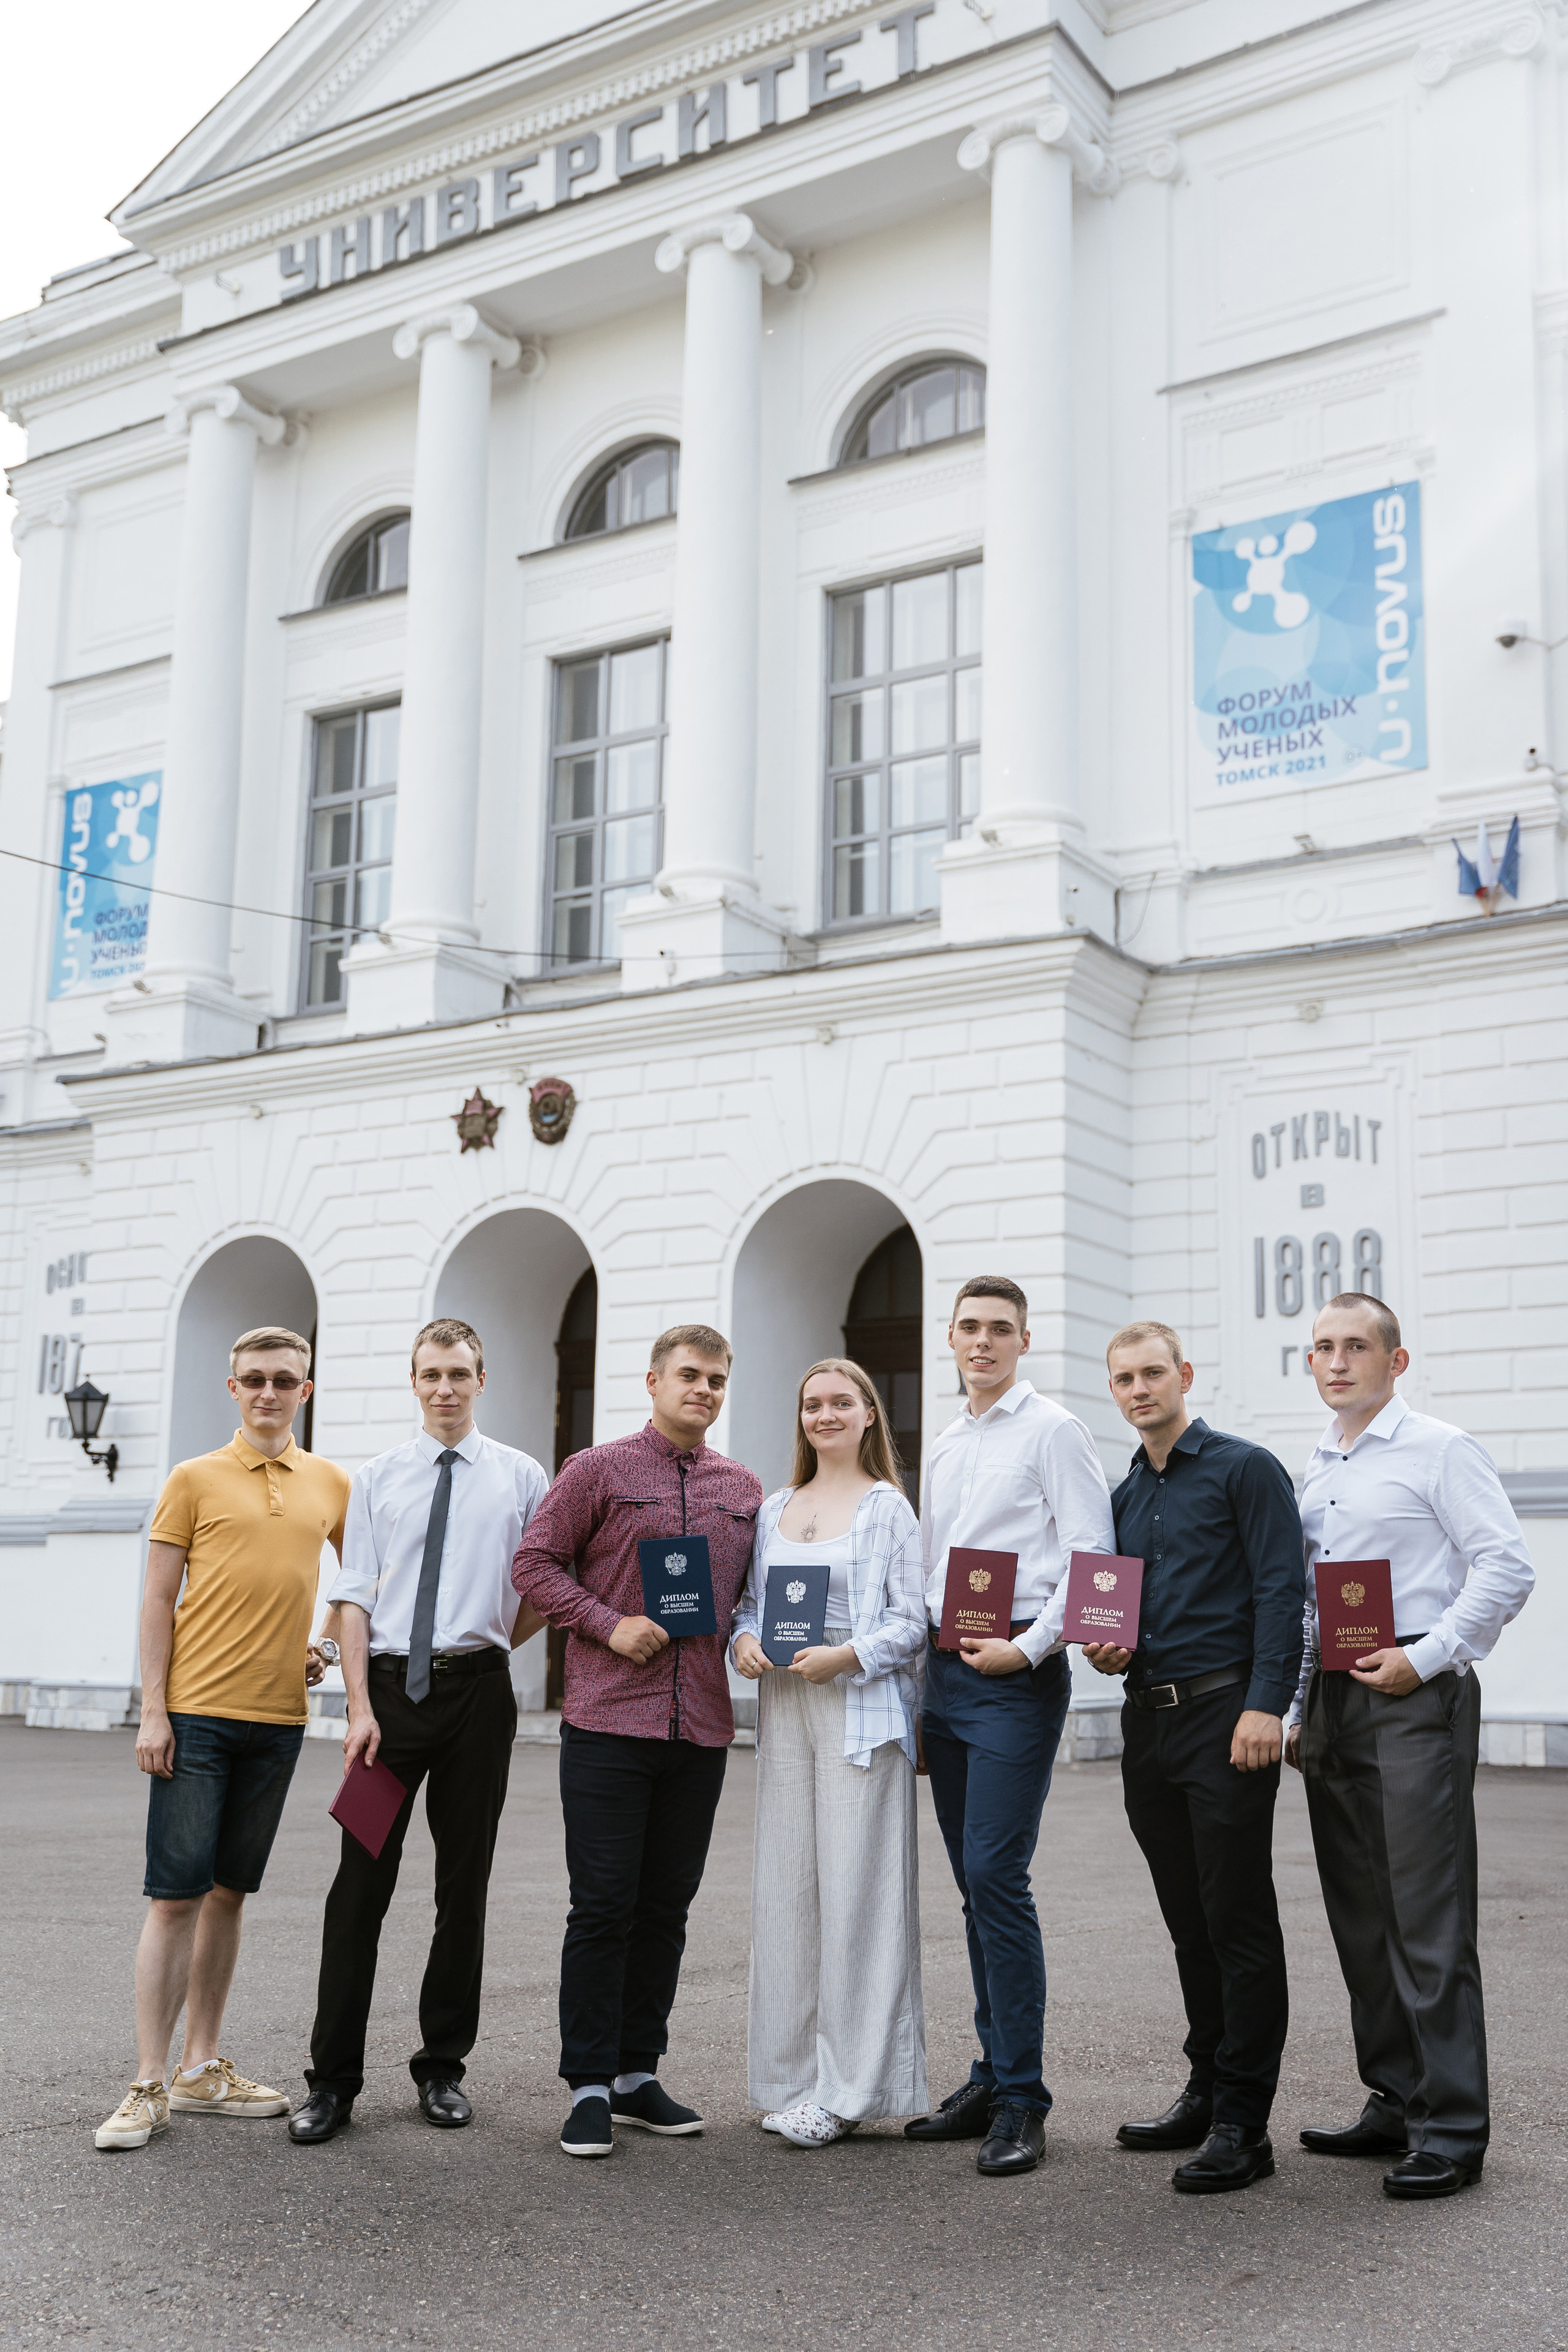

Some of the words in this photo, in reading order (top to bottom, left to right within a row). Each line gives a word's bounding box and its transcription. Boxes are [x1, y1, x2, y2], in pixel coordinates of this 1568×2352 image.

[278, 3, 936, 301] УНИВЕРСИТЕТ
[1217, 680, 1312, 716] ФОРУМ
[1218, 695, 1359, 741] МОЛОДЫХ
[1217, 728, 1324, 766] УЧЕНЫХ
[1216, 761, 1287, 787] ТОМСК
[1286, 754, 1327, 775] 2021
[94, 903, 149, 926] ФОРУМ
[90, 941, 148, 965] УЧЕНЫ
[1251, 1111, 1381, 1179] ОТКРЫТ
[1300, 1183, 1325, 1208] В
[1254, 1228, 1382, 1318] 1888
[71, 1298, 83, 1315] В
[660, 1593, 699, 1604] ДИПЛОМ
[956, 1609, 996, 1620] ДИПЛОМ
[1080, 1619, 1121, 1628] ОБРАЗОВАНИИ
[1081, 1606, 1124, 1618] ДИПЛОМ
[774, 1621, 810, 1630] ДИПЛОМ
[955, 1624, 993, 1632] ОБРАЗОВАНИИ
[1335, 1626, 1378, 1636] ДИПЛОМ
